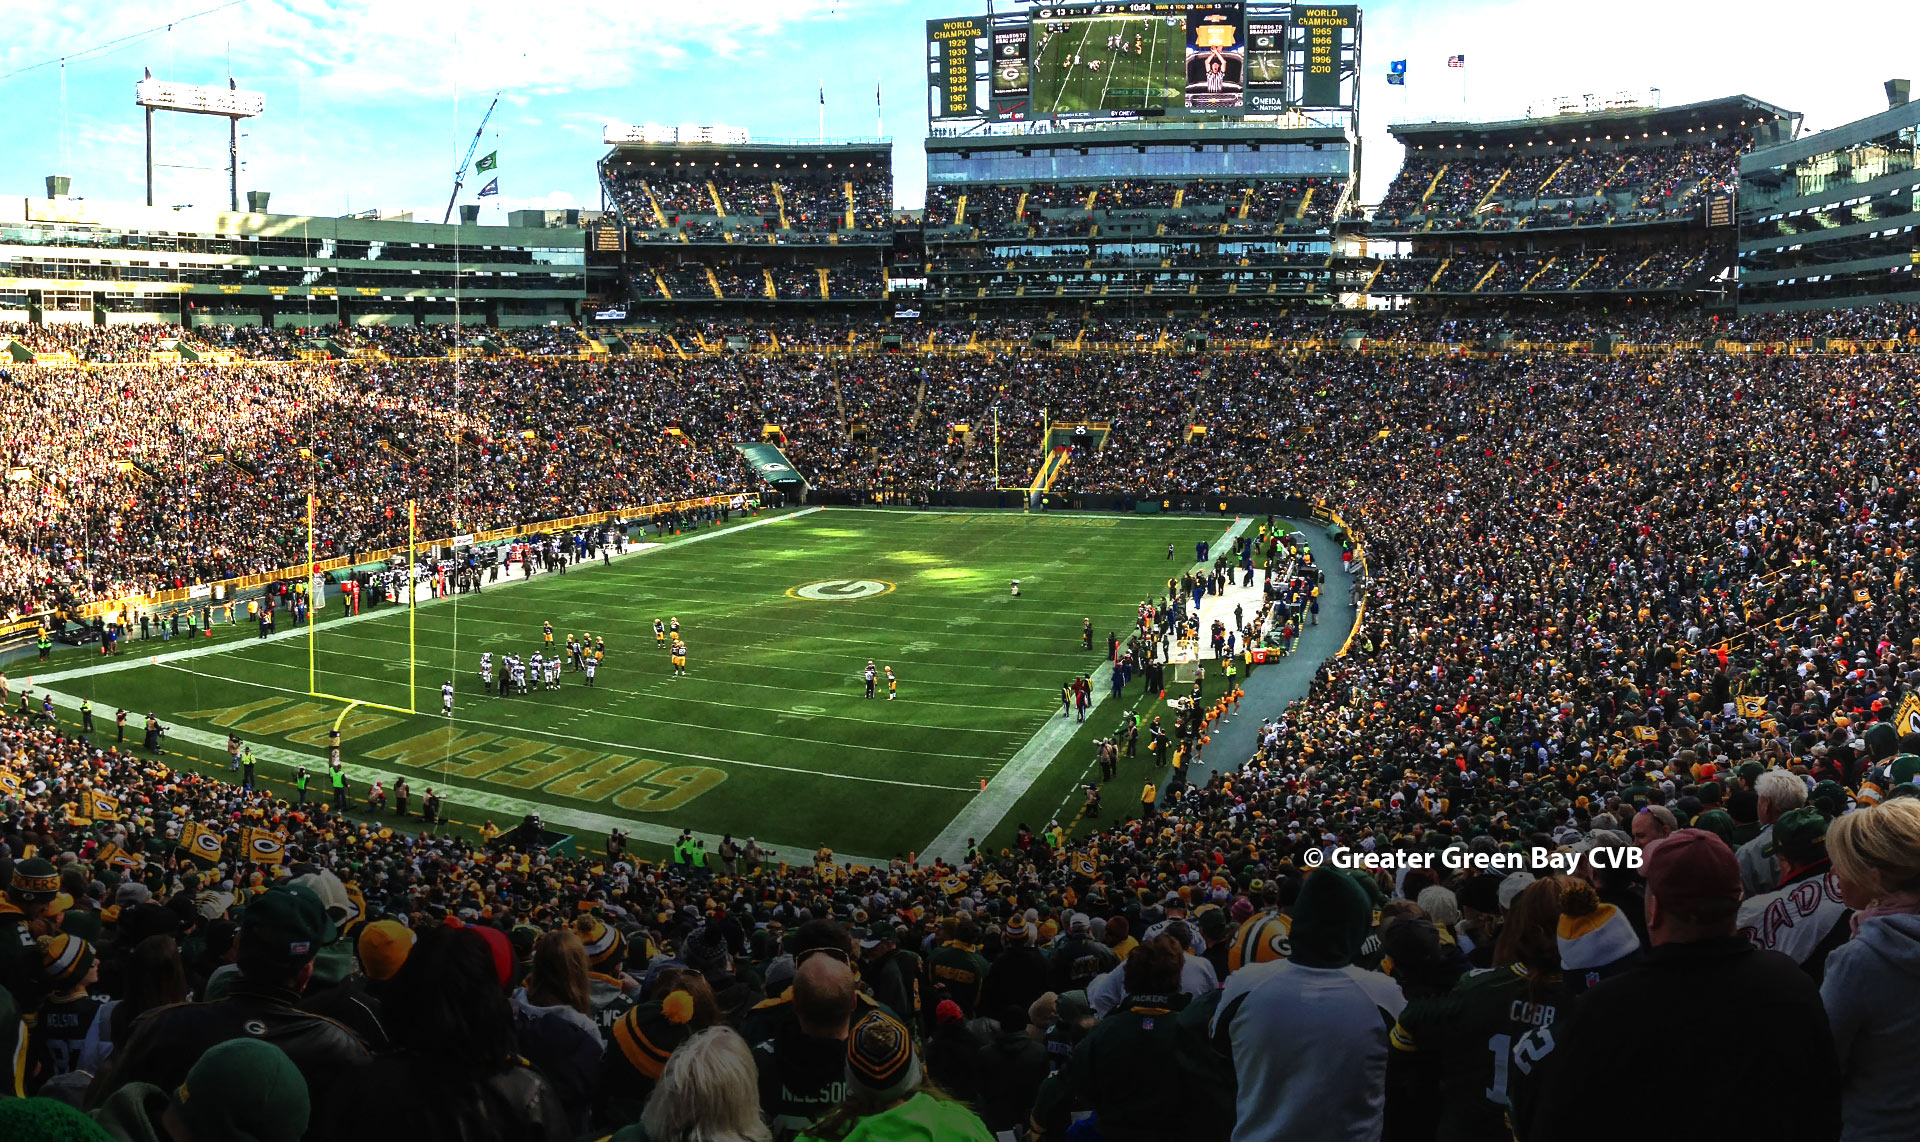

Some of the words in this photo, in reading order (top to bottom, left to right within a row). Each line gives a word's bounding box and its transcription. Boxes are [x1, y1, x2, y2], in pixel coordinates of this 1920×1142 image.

[1056, 8, 1066, 16] 13
[1306, 9, 1338, 17] WORLD
[944, 21, 973, 29] WORLD
[1299, 18, 1348, 26] CHAMPIONS
[934, 29, 981, 39] CHAMPIONS
[949, 39, 967, 47] 1929
[949, 48, 967, 56] 1930
[949, 76, 967, 84] 1939
[949, 85, 967, 93] 1944
[1252, 97, 1281, 105] ONEIDA
[172, 697, 407, 748] BAY
[359, 727, 729, 811] GREEN
[1510, 1000, 1556, 1026] COBB
